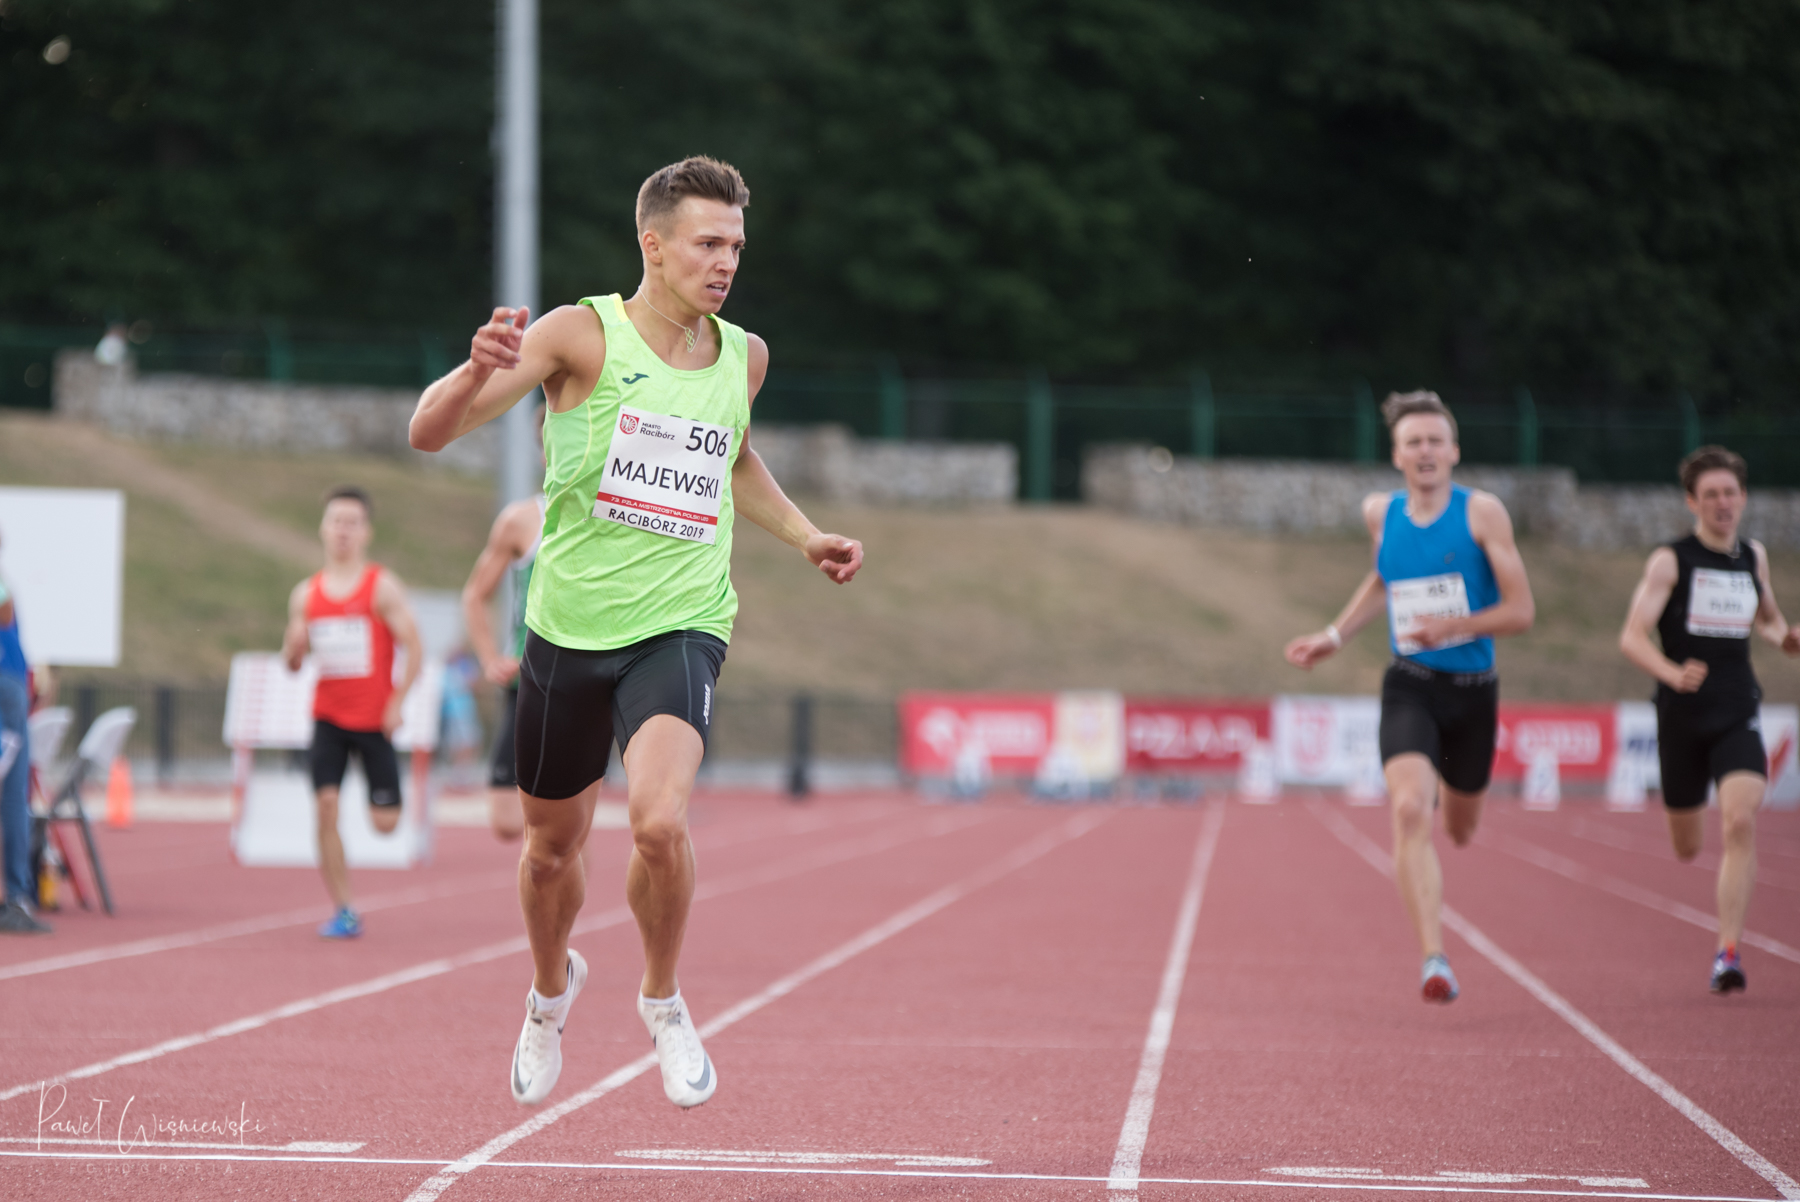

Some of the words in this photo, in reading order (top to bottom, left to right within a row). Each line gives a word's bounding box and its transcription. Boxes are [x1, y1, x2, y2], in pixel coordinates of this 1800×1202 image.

[640, 427, 675, 440] Racibórz
[642, 422, 661, 430] MIASTO
[685, 426, 728, 457] 506
[611, 457, 719, 499] MAJEWSKI
[621, 499, 638, 508] PZLA
[638, 503, 682, 517] MISTRZOSTWA
[682, 512, 701, 521] POLSKI
[608, 508, 677, 533] RACIBÓRZ
[679, 524, 704, 539] 2019
